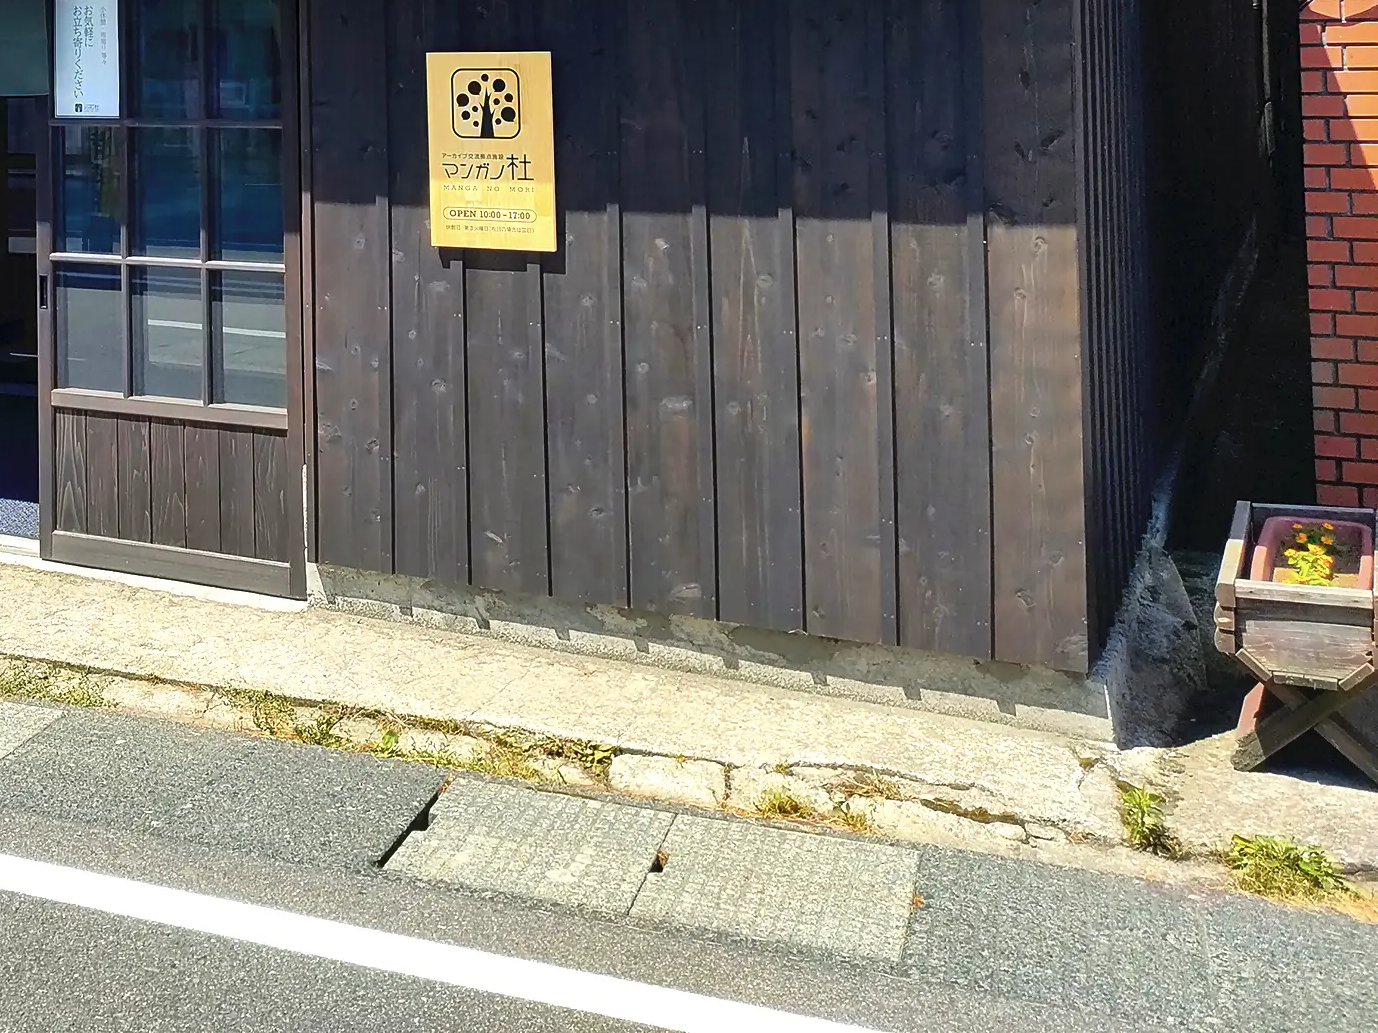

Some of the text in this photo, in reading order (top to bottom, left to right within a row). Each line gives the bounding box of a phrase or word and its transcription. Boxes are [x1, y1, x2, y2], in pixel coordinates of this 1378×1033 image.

[83, 5, 94, 47] お気軽に
[72, 5, 84, 98] お立ち寄りください
[442, 154, 535, 181] マンガノ杜
[443, 184, 478, 192] MANGA
[449, 209, 477, 218] OPEN
